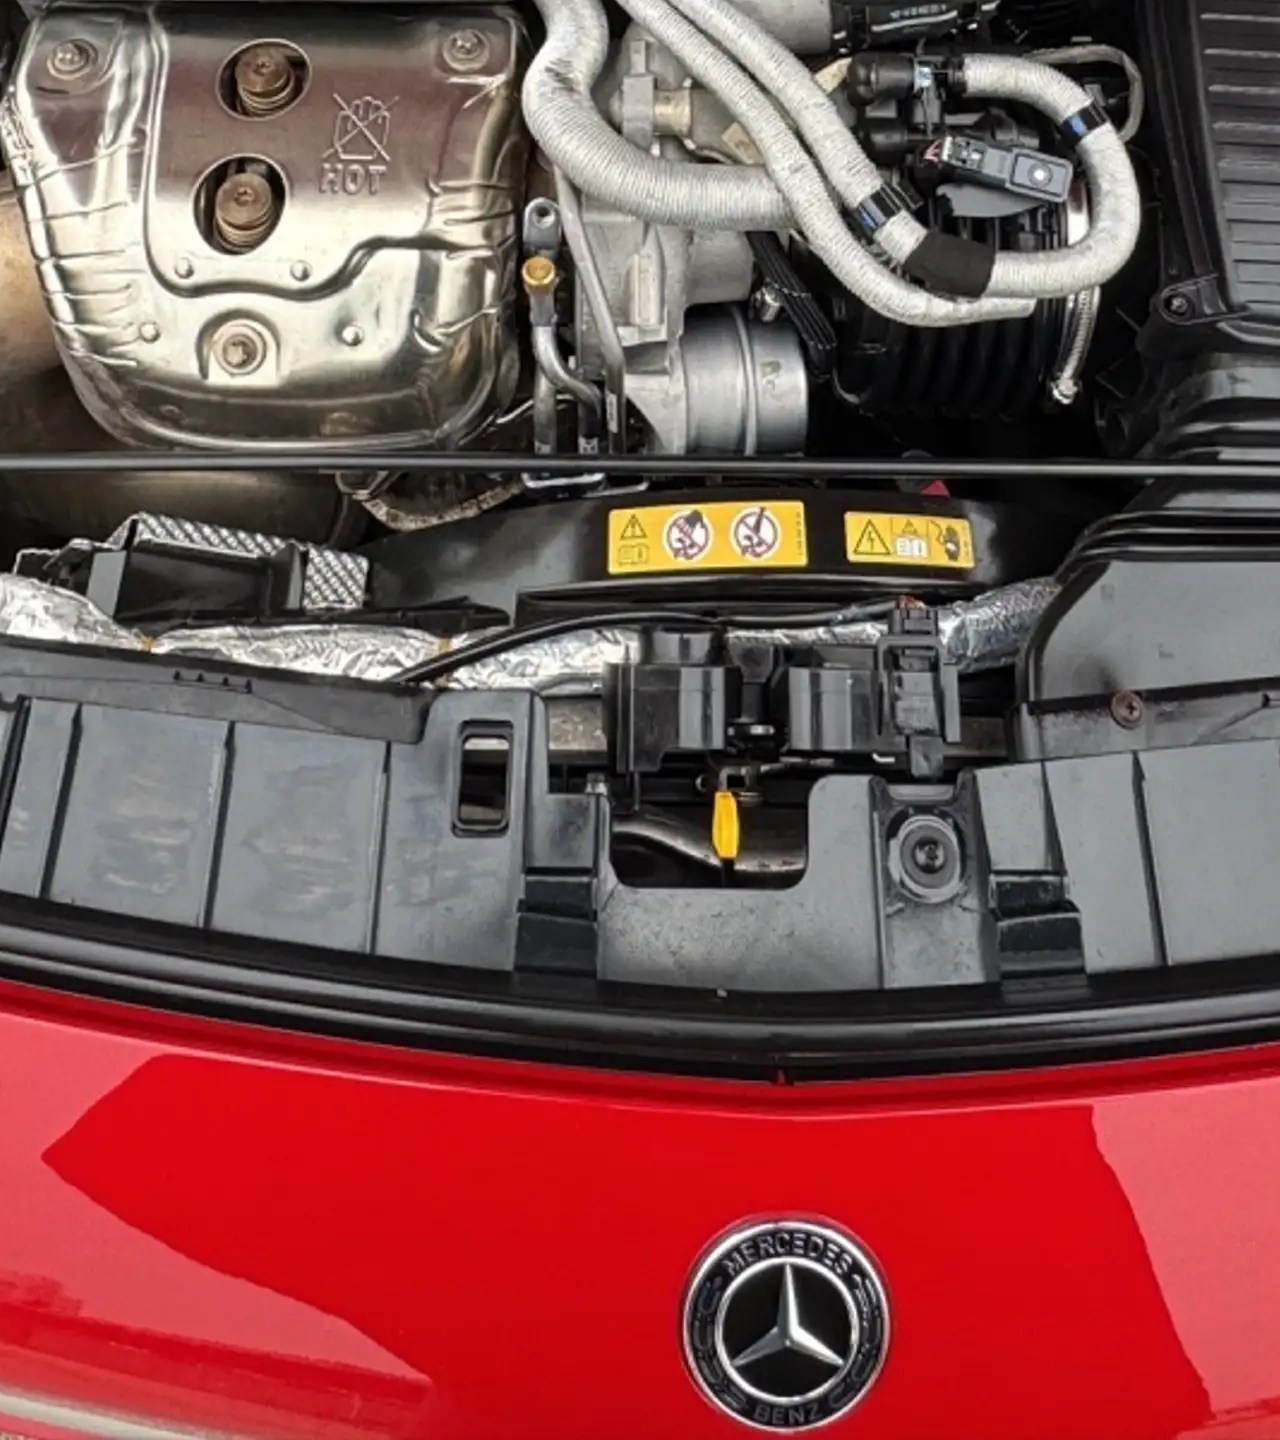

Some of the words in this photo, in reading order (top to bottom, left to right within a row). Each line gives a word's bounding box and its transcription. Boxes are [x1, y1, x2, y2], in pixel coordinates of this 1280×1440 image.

[318, 163, 388, 195] HOT
[720, 1231, 853, 1276] MERCEDES
[753, 1402, 824, 1425] BENZ
